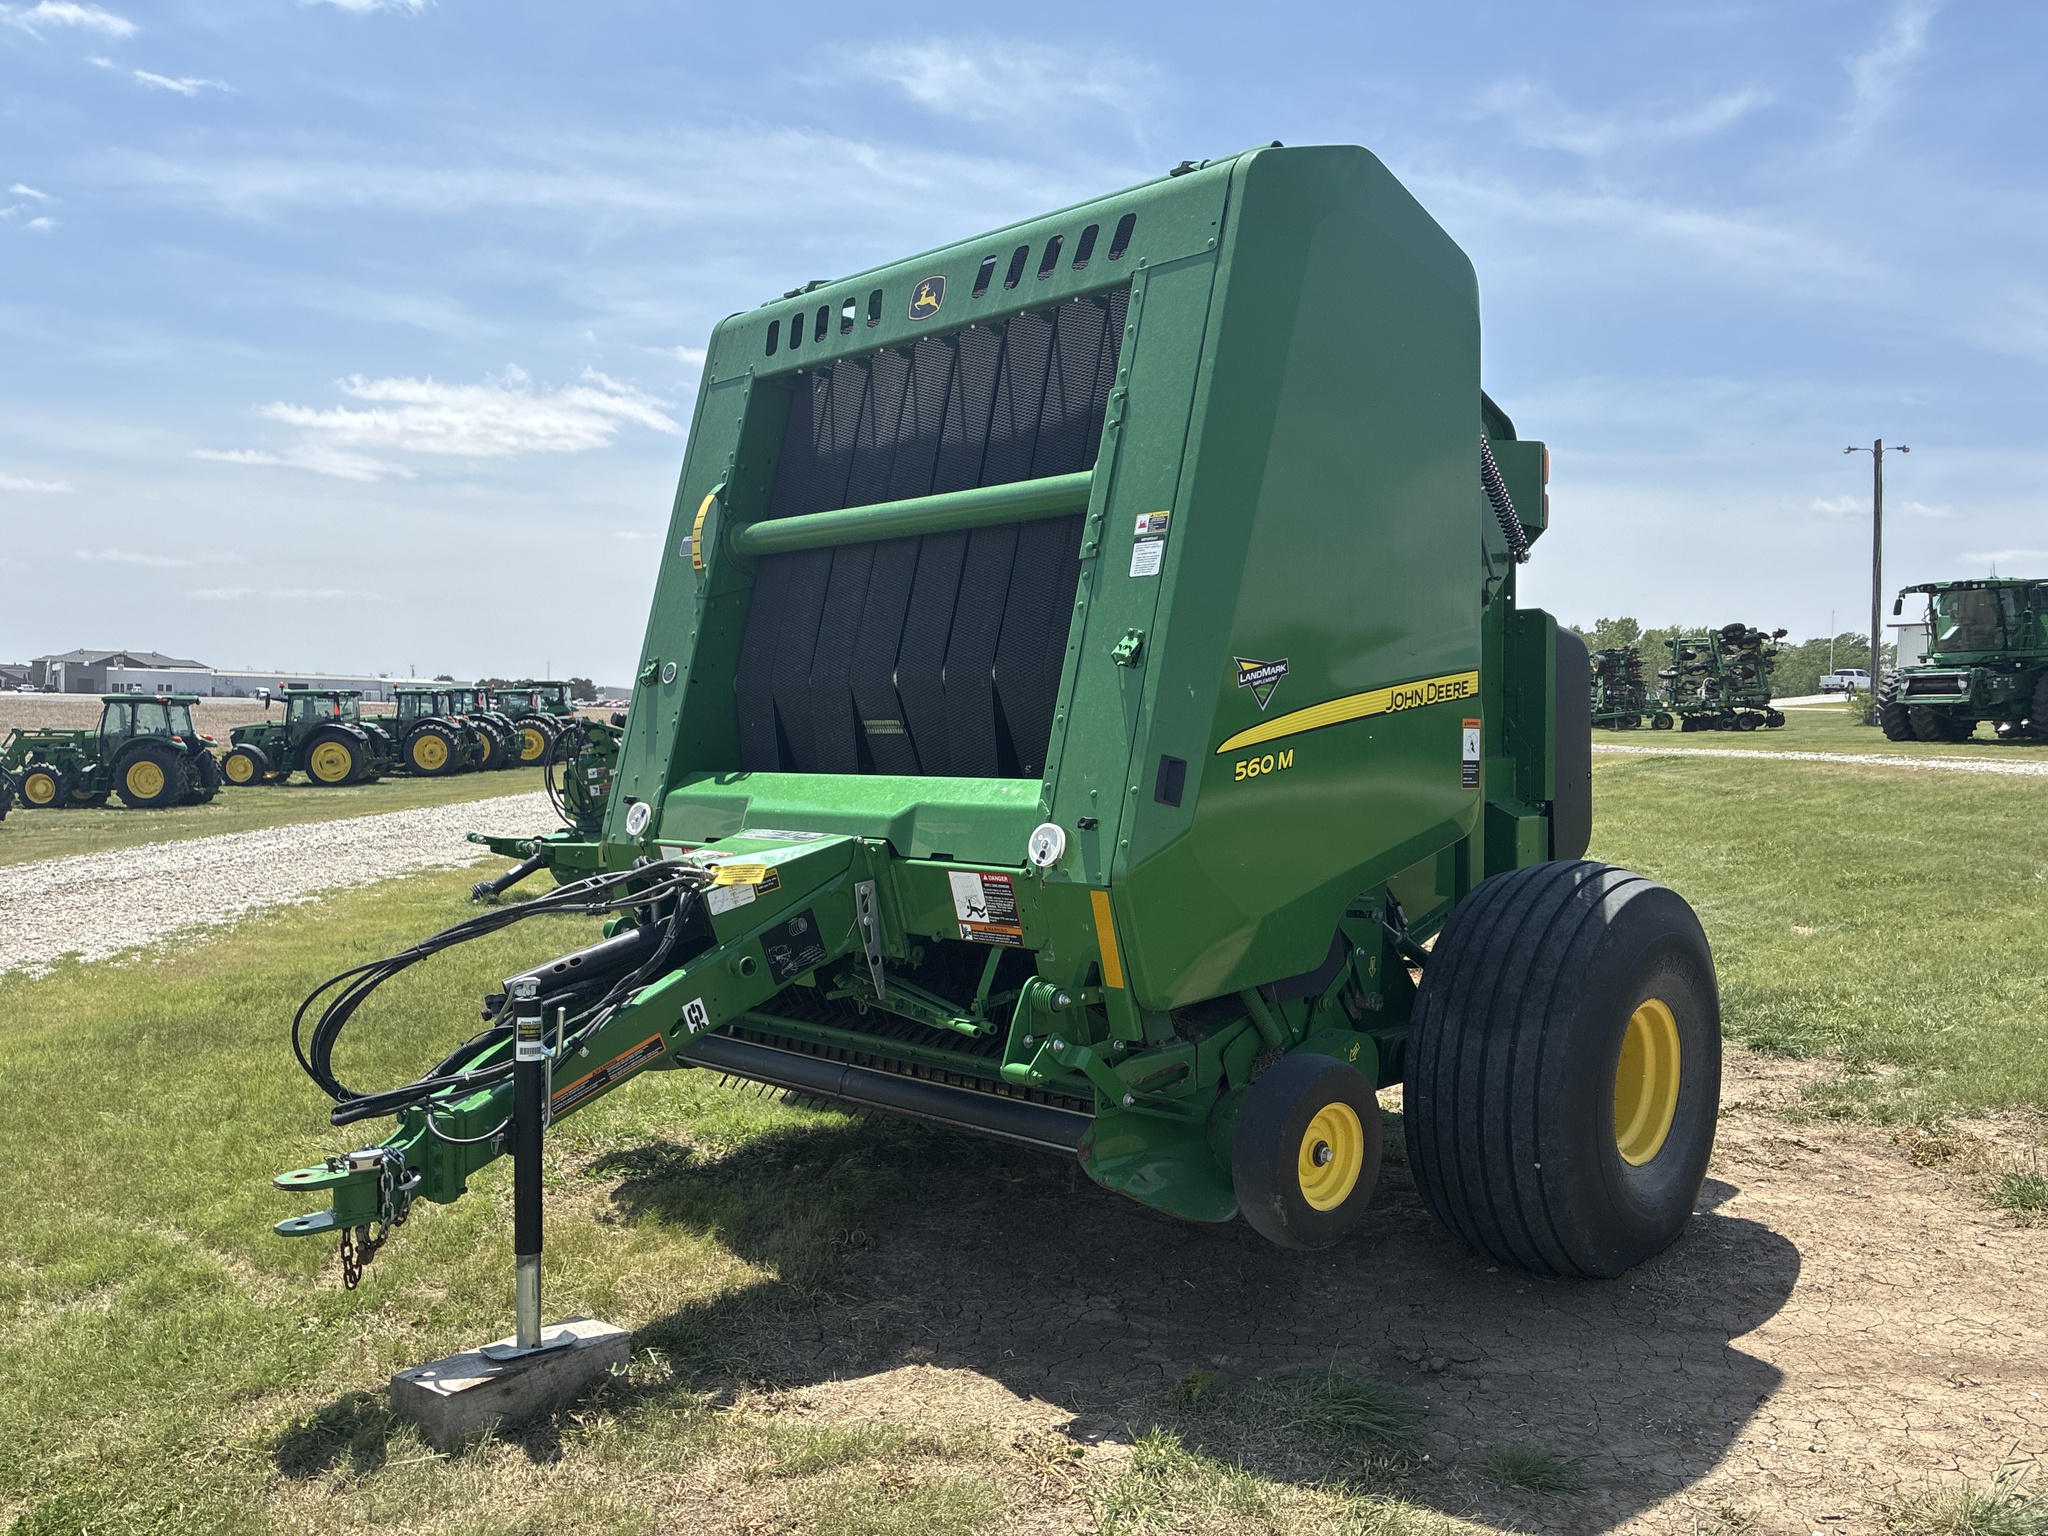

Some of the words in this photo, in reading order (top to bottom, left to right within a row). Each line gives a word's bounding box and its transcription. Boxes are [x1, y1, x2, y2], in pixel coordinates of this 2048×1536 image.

[1253, 675, 1278, 686] IMPLEMENT
[1386, 688, 1424, 711] JOHN
[1427, 680, 1469, 702] DEERE
[1234, 754, 1275, 781] 560
[1277, 748, 1294, 770] M
